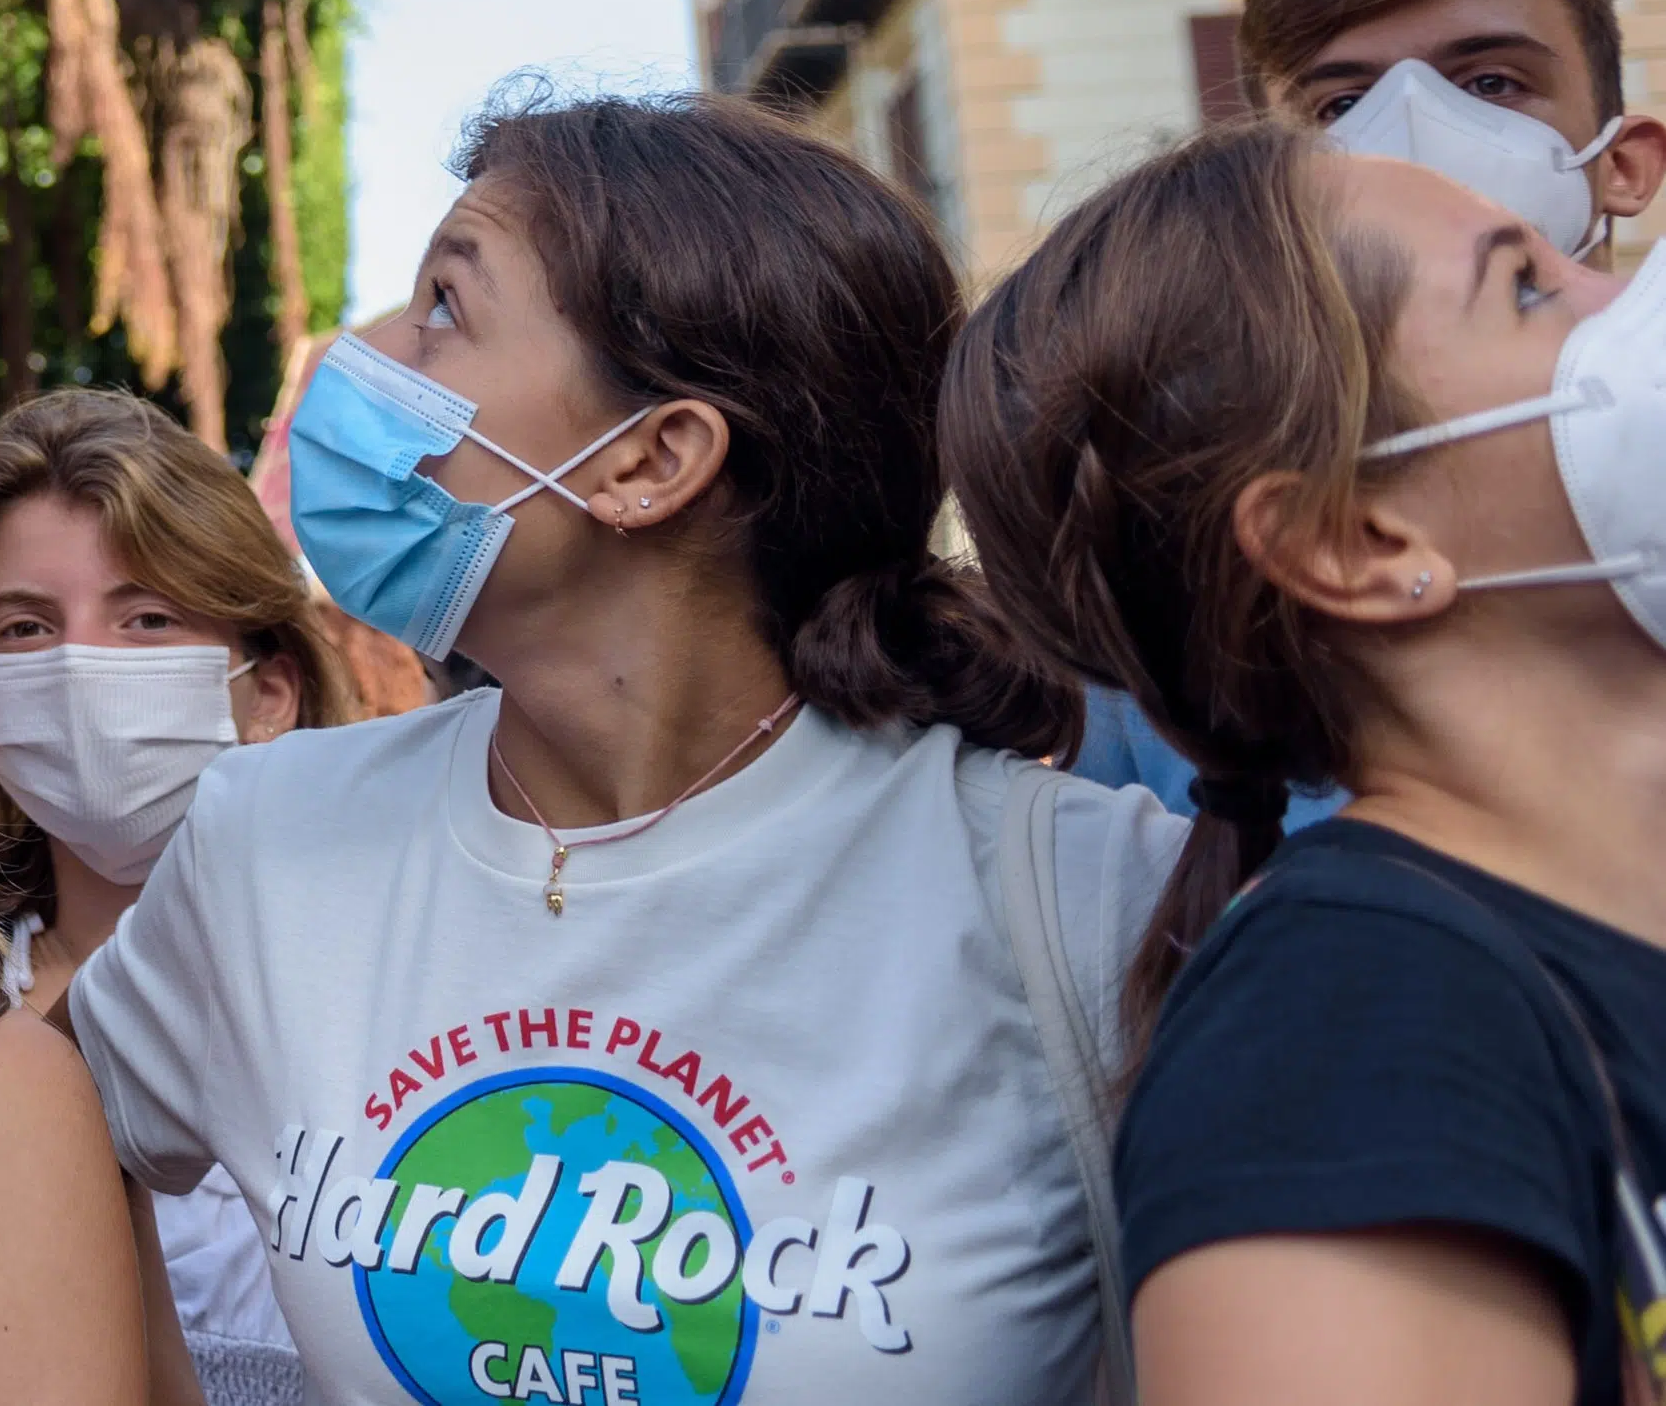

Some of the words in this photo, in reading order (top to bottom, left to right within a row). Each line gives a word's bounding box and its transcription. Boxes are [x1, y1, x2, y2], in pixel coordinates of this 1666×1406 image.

[364, 1024, 478, 1131] SAVE
[483, 1008, 593, 1053] THE
[605, 1015, 788, 1176] PLANET
[267, 1123, 564, 1285] Hard
[555, 1176, 914, 1355] Rock
[469, 1340, 641, 1406] CAFE
